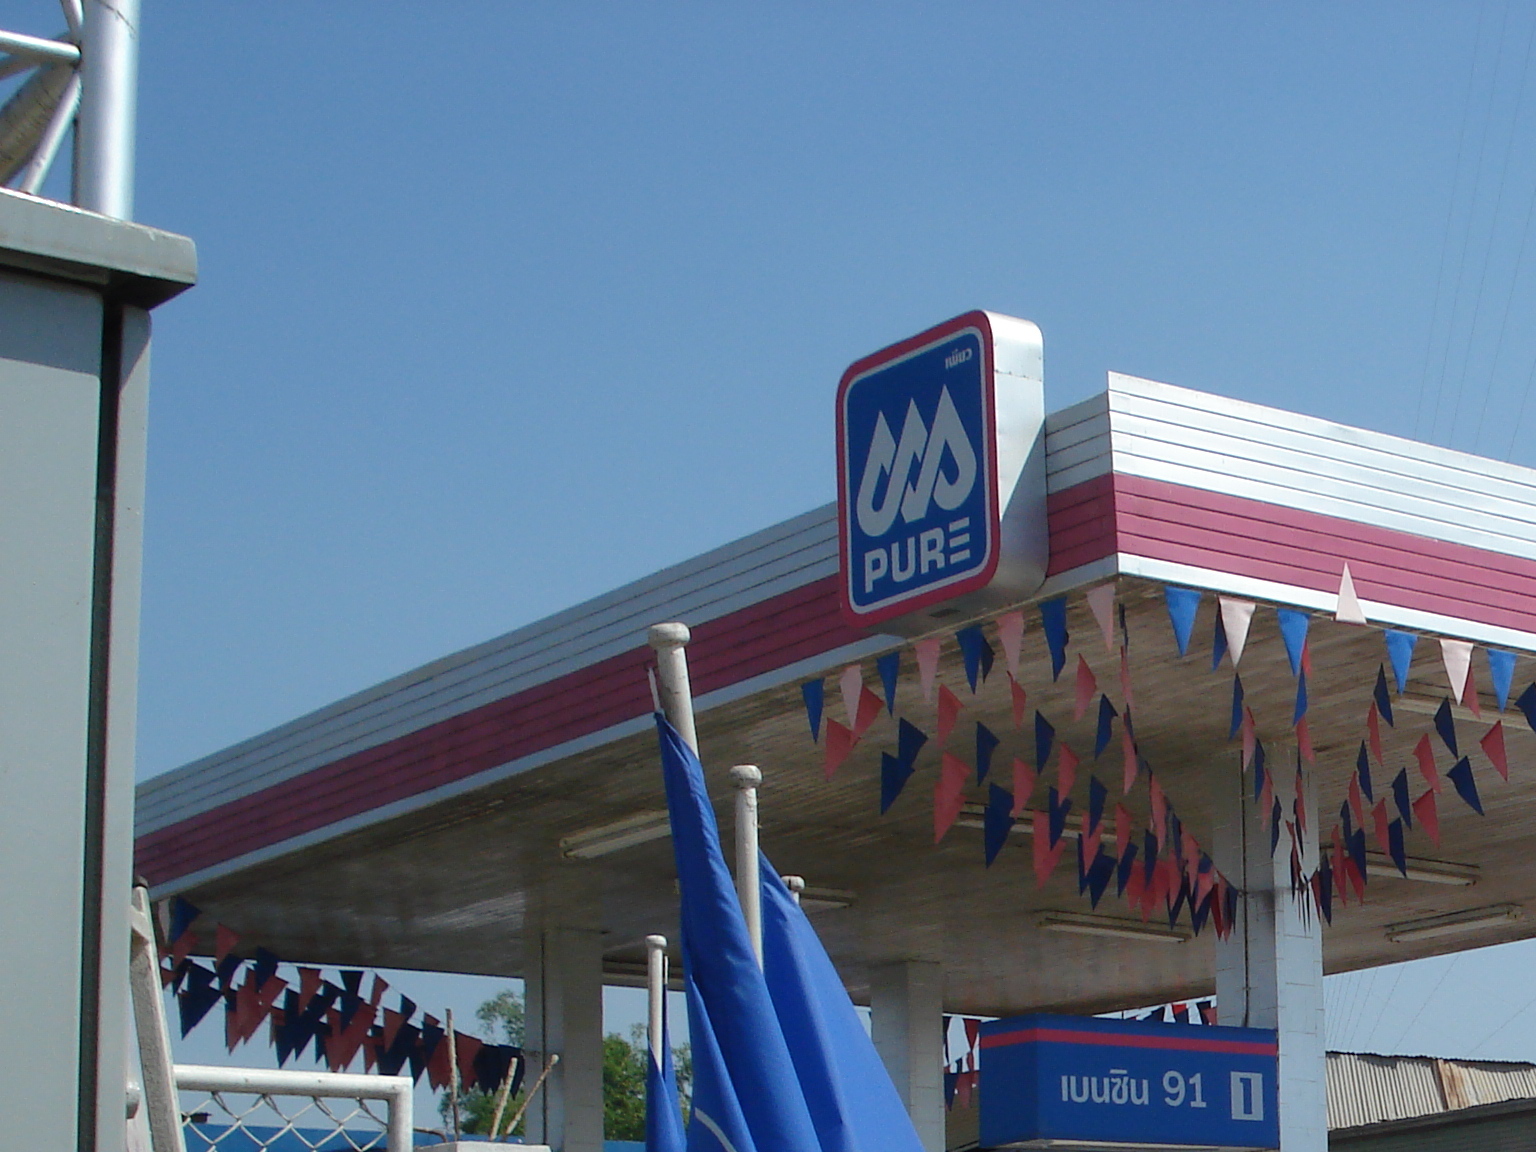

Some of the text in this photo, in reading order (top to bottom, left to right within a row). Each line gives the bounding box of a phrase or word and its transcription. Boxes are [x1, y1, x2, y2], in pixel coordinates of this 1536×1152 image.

[864, 517, 971, 593] PURE
[1061, 1068, 1208, 1109] เบนซิน 91
